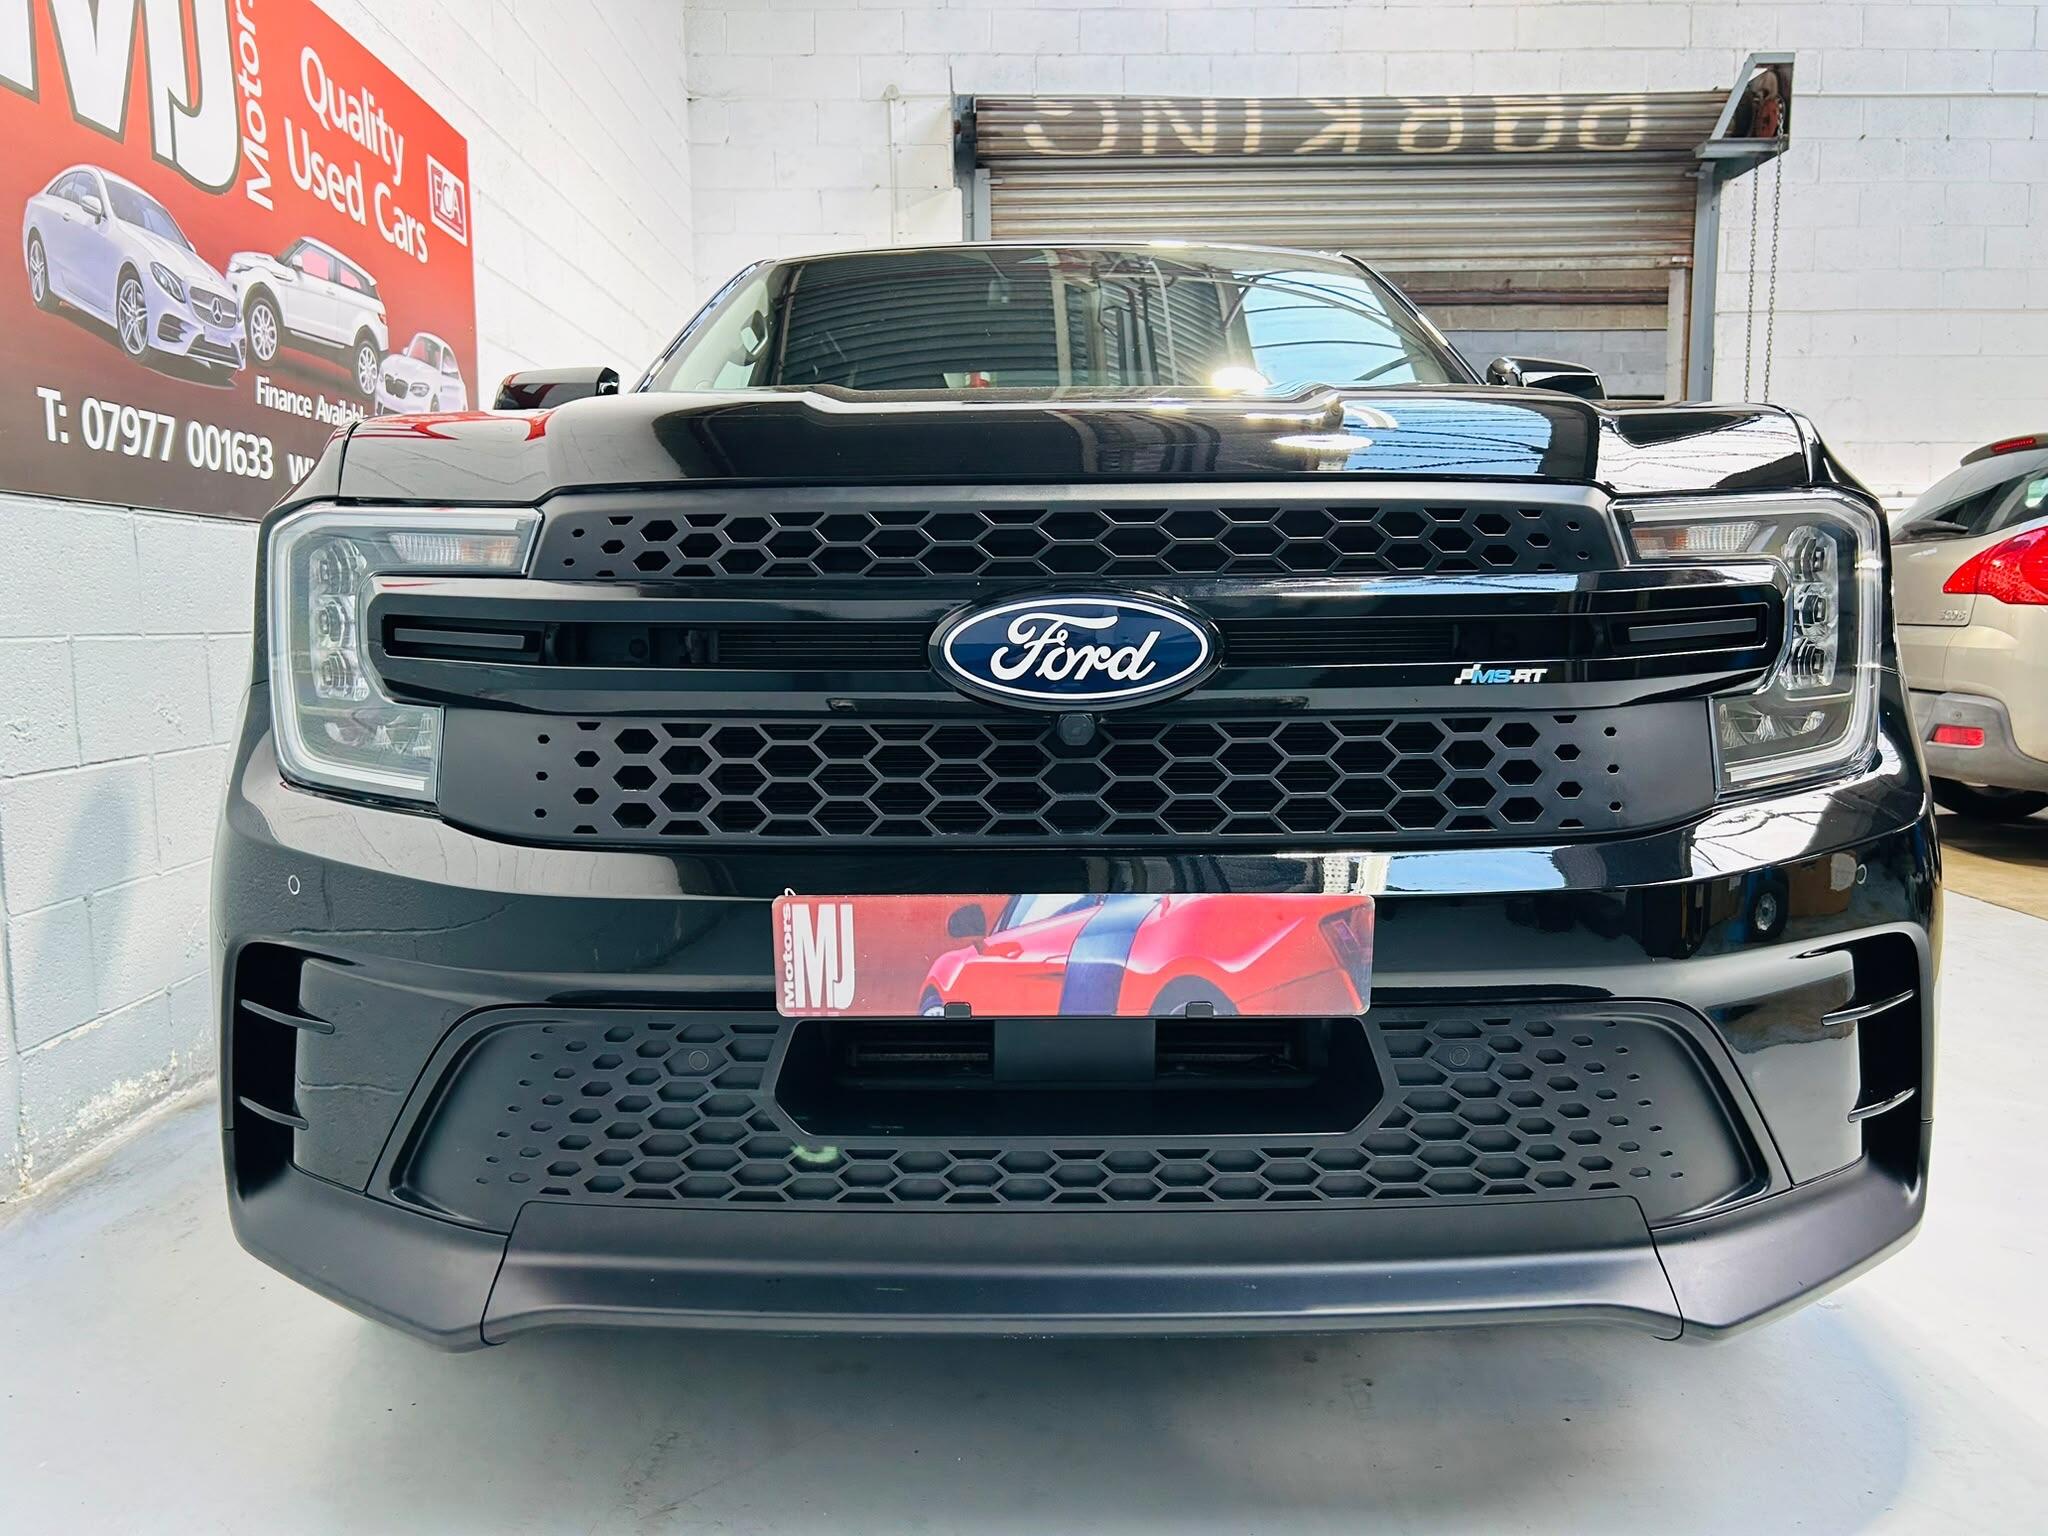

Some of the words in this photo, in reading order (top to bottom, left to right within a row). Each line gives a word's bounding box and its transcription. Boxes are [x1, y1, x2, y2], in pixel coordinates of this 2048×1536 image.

[235, 0, 274, 212] Motor
[300, 46, 404, 187] Quality
[284, 116, 367, 227] Used
[374, 181, 429, 264] Cars
[36, 386, 70, 444] T:
[82, 397, 176, 462] 07977
[187, 420, 274, 480] 001633
[256, 375, 313, 419] Finance
[989, 611, 1161, 682] Ford
[782, 902, 795, 1008] Motors
[792, 903, 856, 1010] MJ
